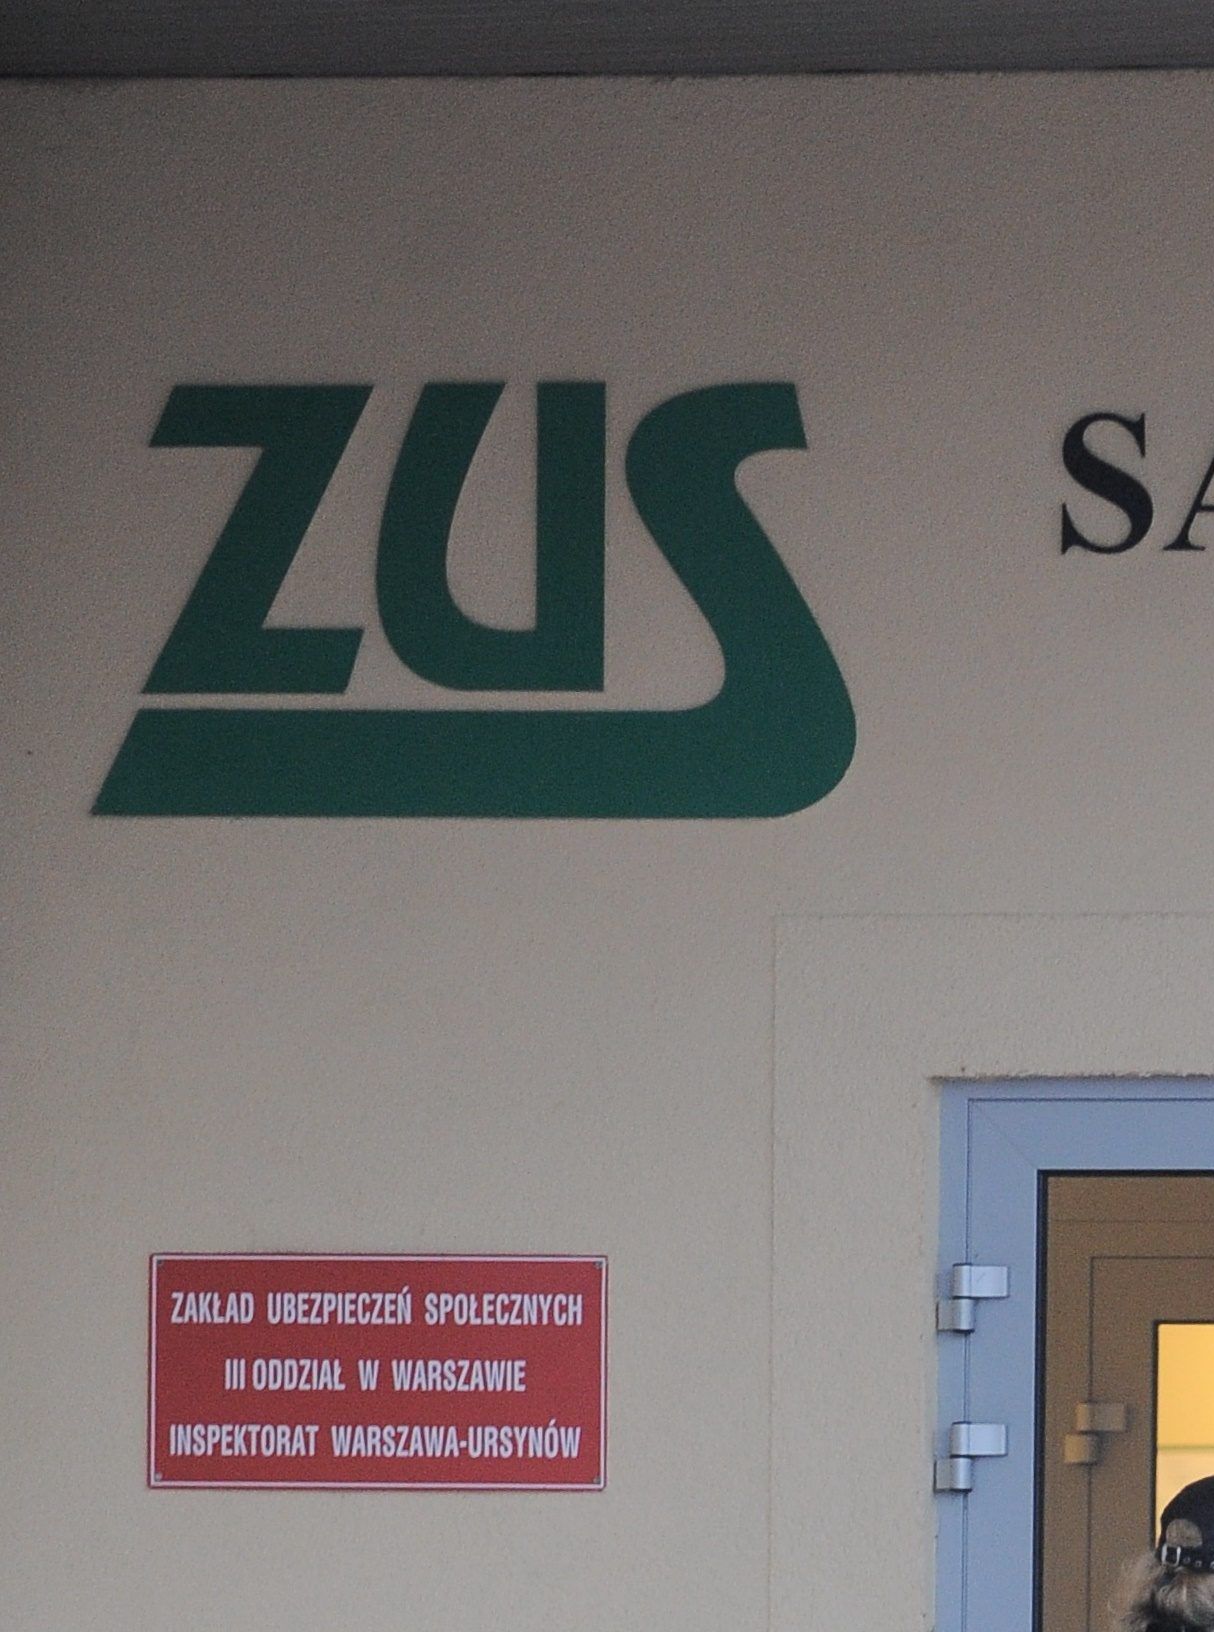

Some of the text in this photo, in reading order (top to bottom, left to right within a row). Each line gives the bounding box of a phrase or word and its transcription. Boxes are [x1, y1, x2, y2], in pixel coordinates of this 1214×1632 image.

[90, 380, 858, 819] ZUS
[171, 1286, 583, 1327] ZAKŁAD UBEZPIECZEŃ SPOŁECZNYCH
[225, 1358, 526, 1393] III ODDZIAŁ W WARSZAWIE
[169, 1419, 581, 1459] INSPEKTORAT WARSZAWA-URSYNÓW
